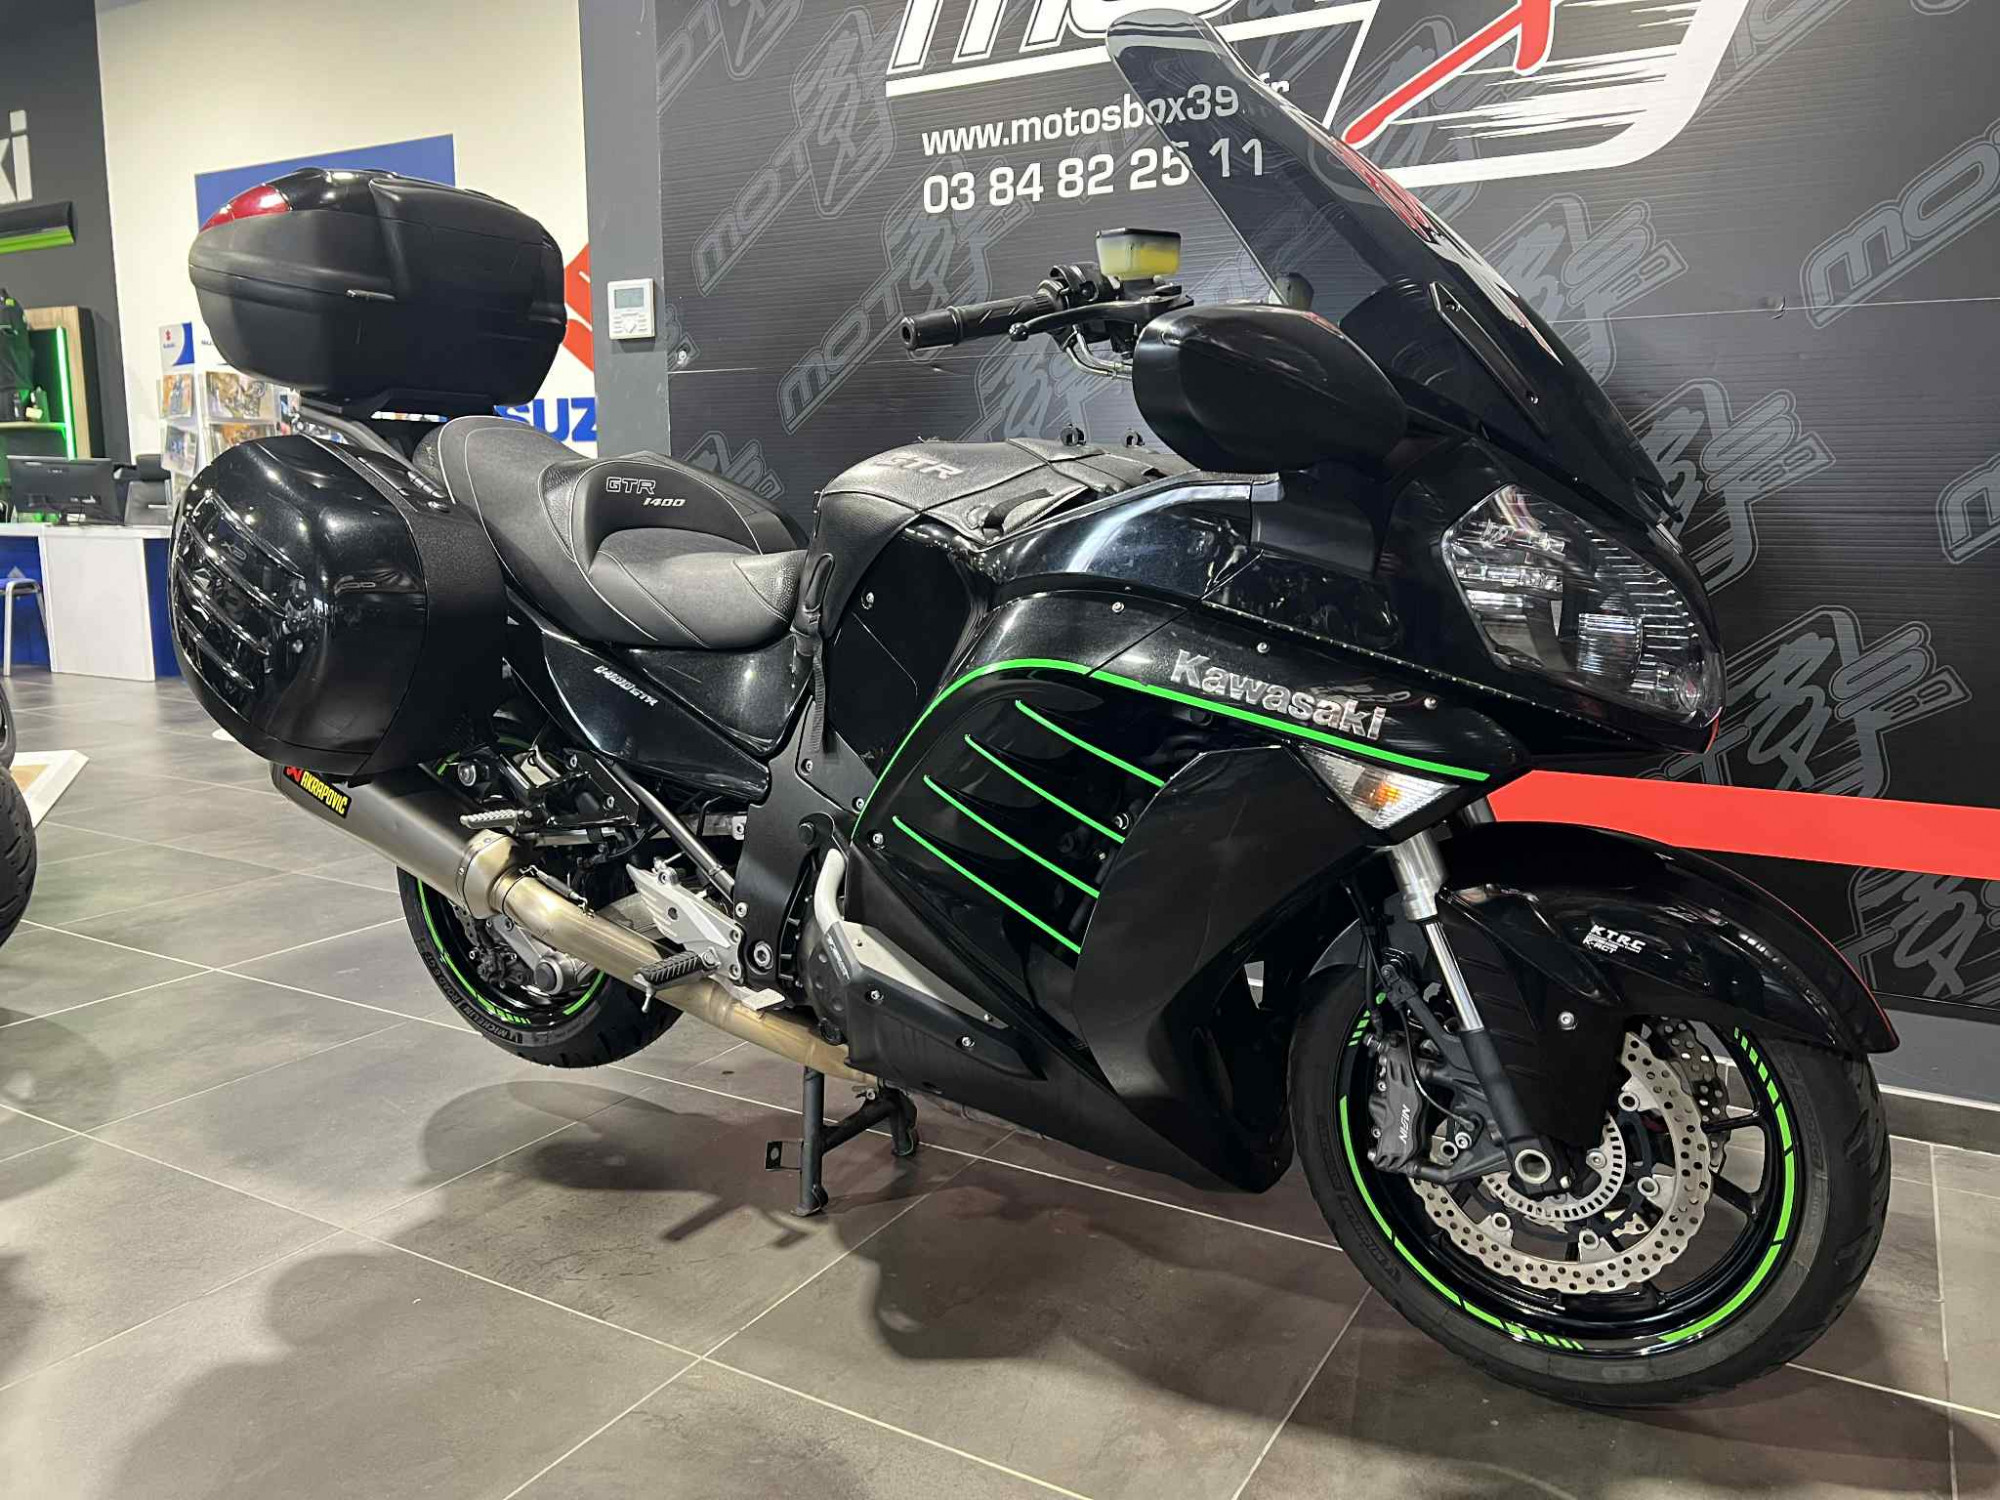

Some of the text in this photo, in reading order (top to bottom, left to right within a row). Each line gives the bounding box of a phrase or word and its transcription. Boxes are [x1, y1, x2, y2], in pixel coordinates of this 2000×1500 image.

[922, 137, 1265, 214] 03 84 82 25 11
[606, 476, 656, 495] GTR
[642, 497, 686, 507] 1400
[1170, 648, 1387, 741] Kawasaki
